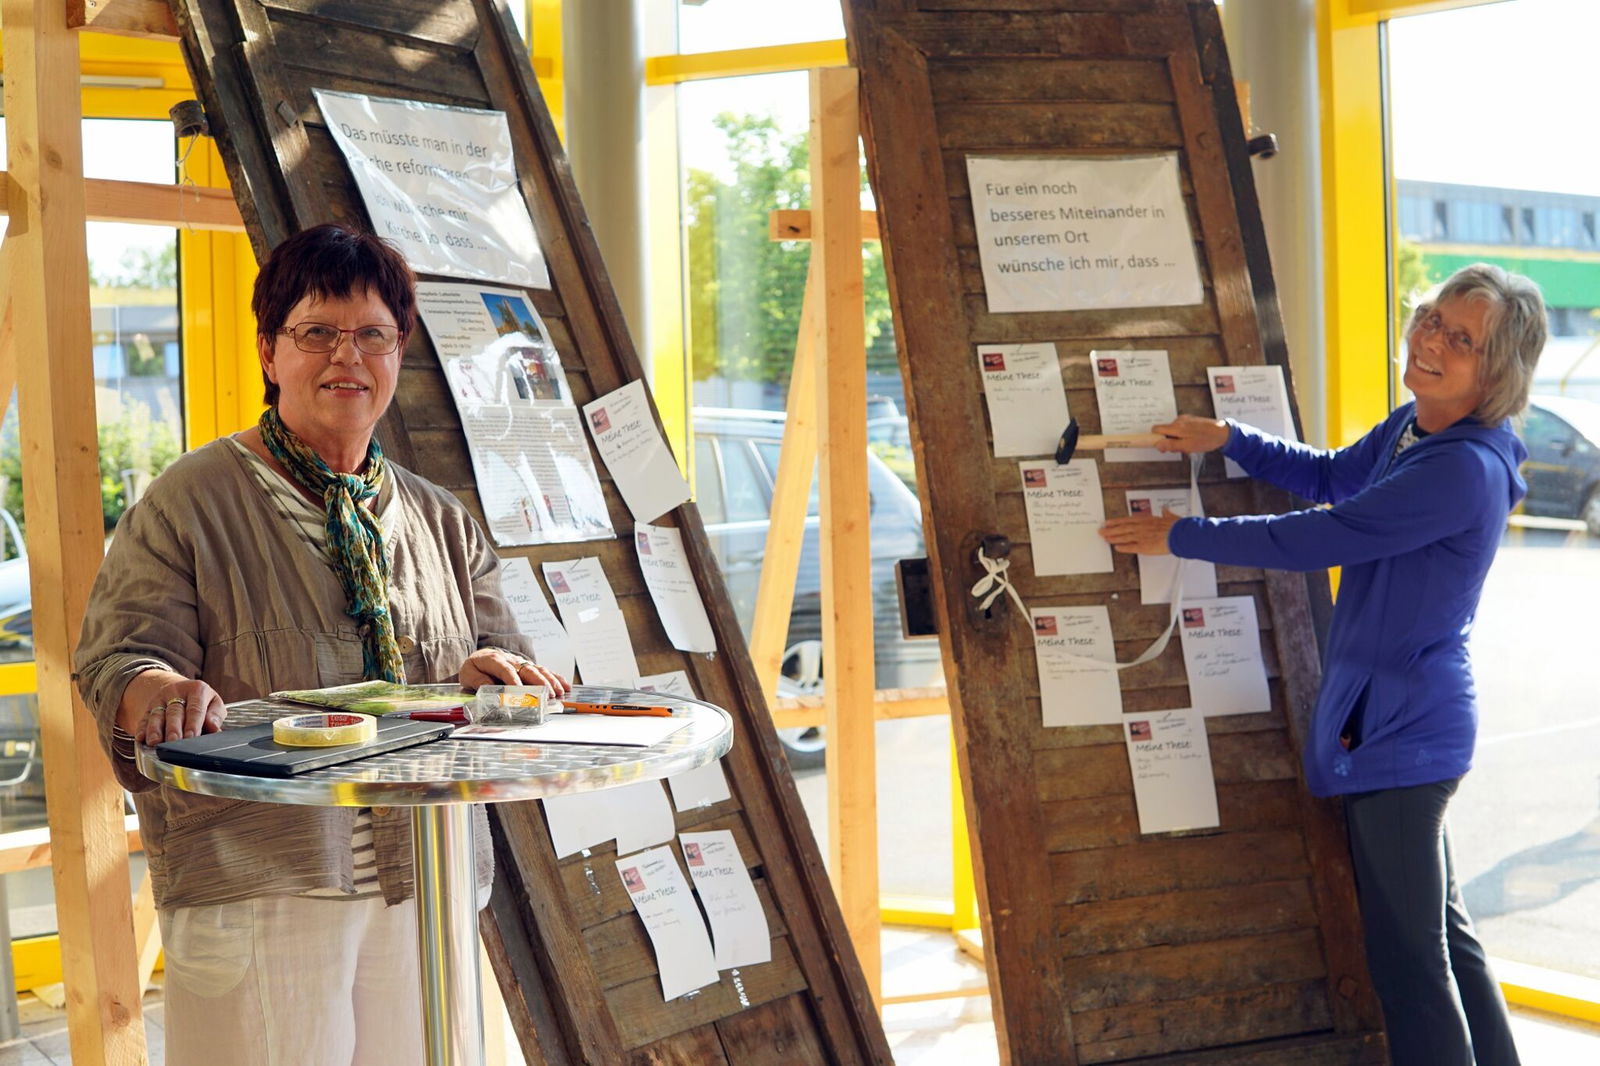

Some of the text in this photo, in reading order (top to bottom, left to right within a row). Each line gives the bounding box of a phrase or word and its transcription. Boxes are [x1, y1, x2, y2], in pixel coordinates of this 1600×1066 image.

[341, 122, 488, 158] Das müsste man in der
[986, 181, 1077, 196] Für ein noch
[448, 207, 469, 221] mir
[990, 204, 1165, 223] besseres Miteinander in
[446, 232, 474, 249] dass
[994, 230, 1090, 247] unserem Ort
[998, 257, 1065, 274] wünsche
[1069, 255, 1091, 270] ich
[1096, 255, 1124, 270] mir,
[1127, 254, 1159, 269] dass
